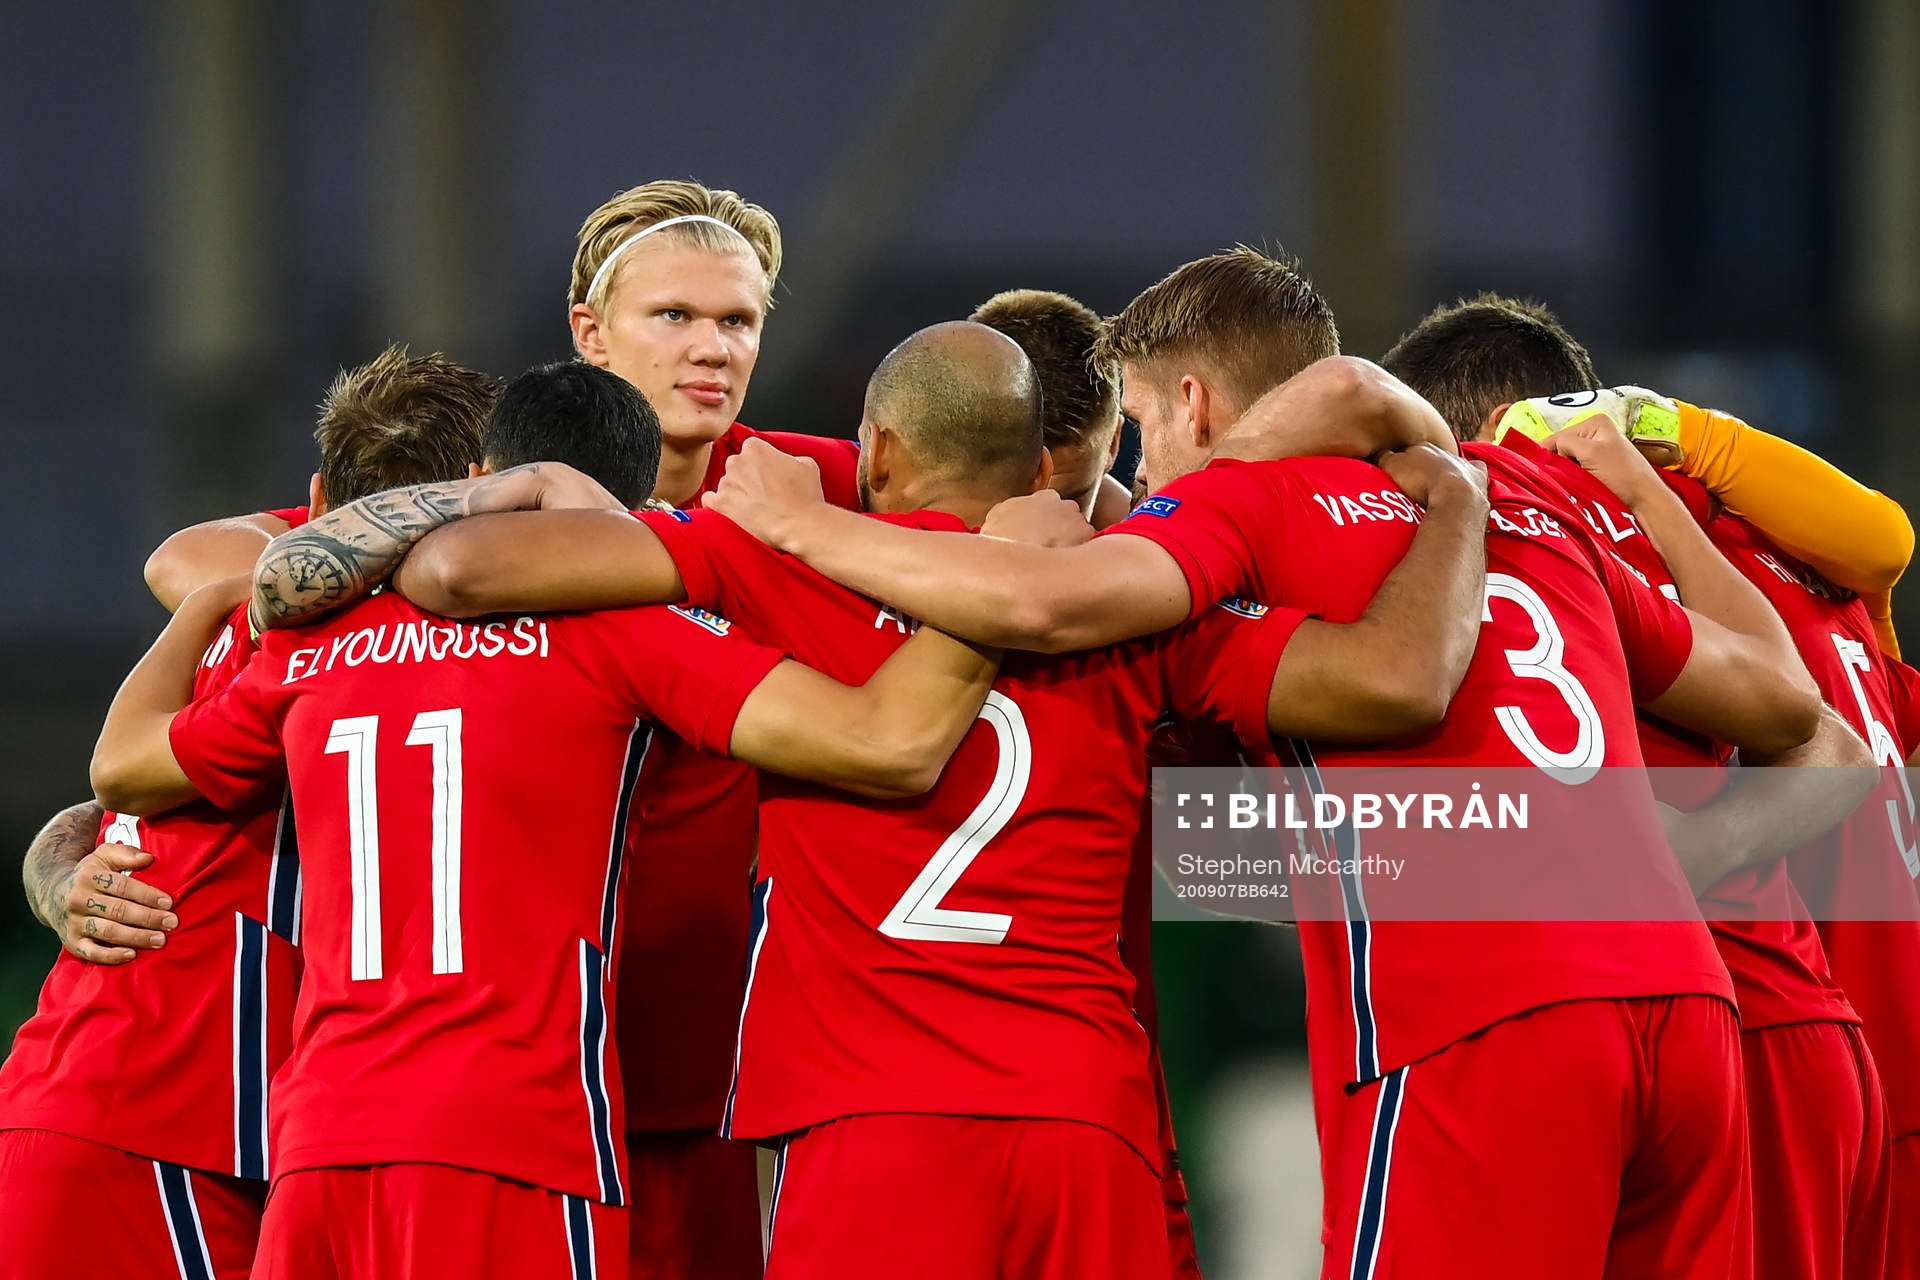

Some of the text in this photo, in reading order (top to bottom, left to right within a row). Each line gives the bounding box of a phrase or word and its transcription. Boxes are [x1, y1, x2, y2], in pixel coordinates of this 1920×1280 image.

[1313, 489, 1427, 526] VASS
[281, 616, 549, 686] ELYOUNOUSSI
[1480, 572, 1606, 785] 3
[324, 708, 464, 981] 11
[877, 689, 1032, 945] 2
